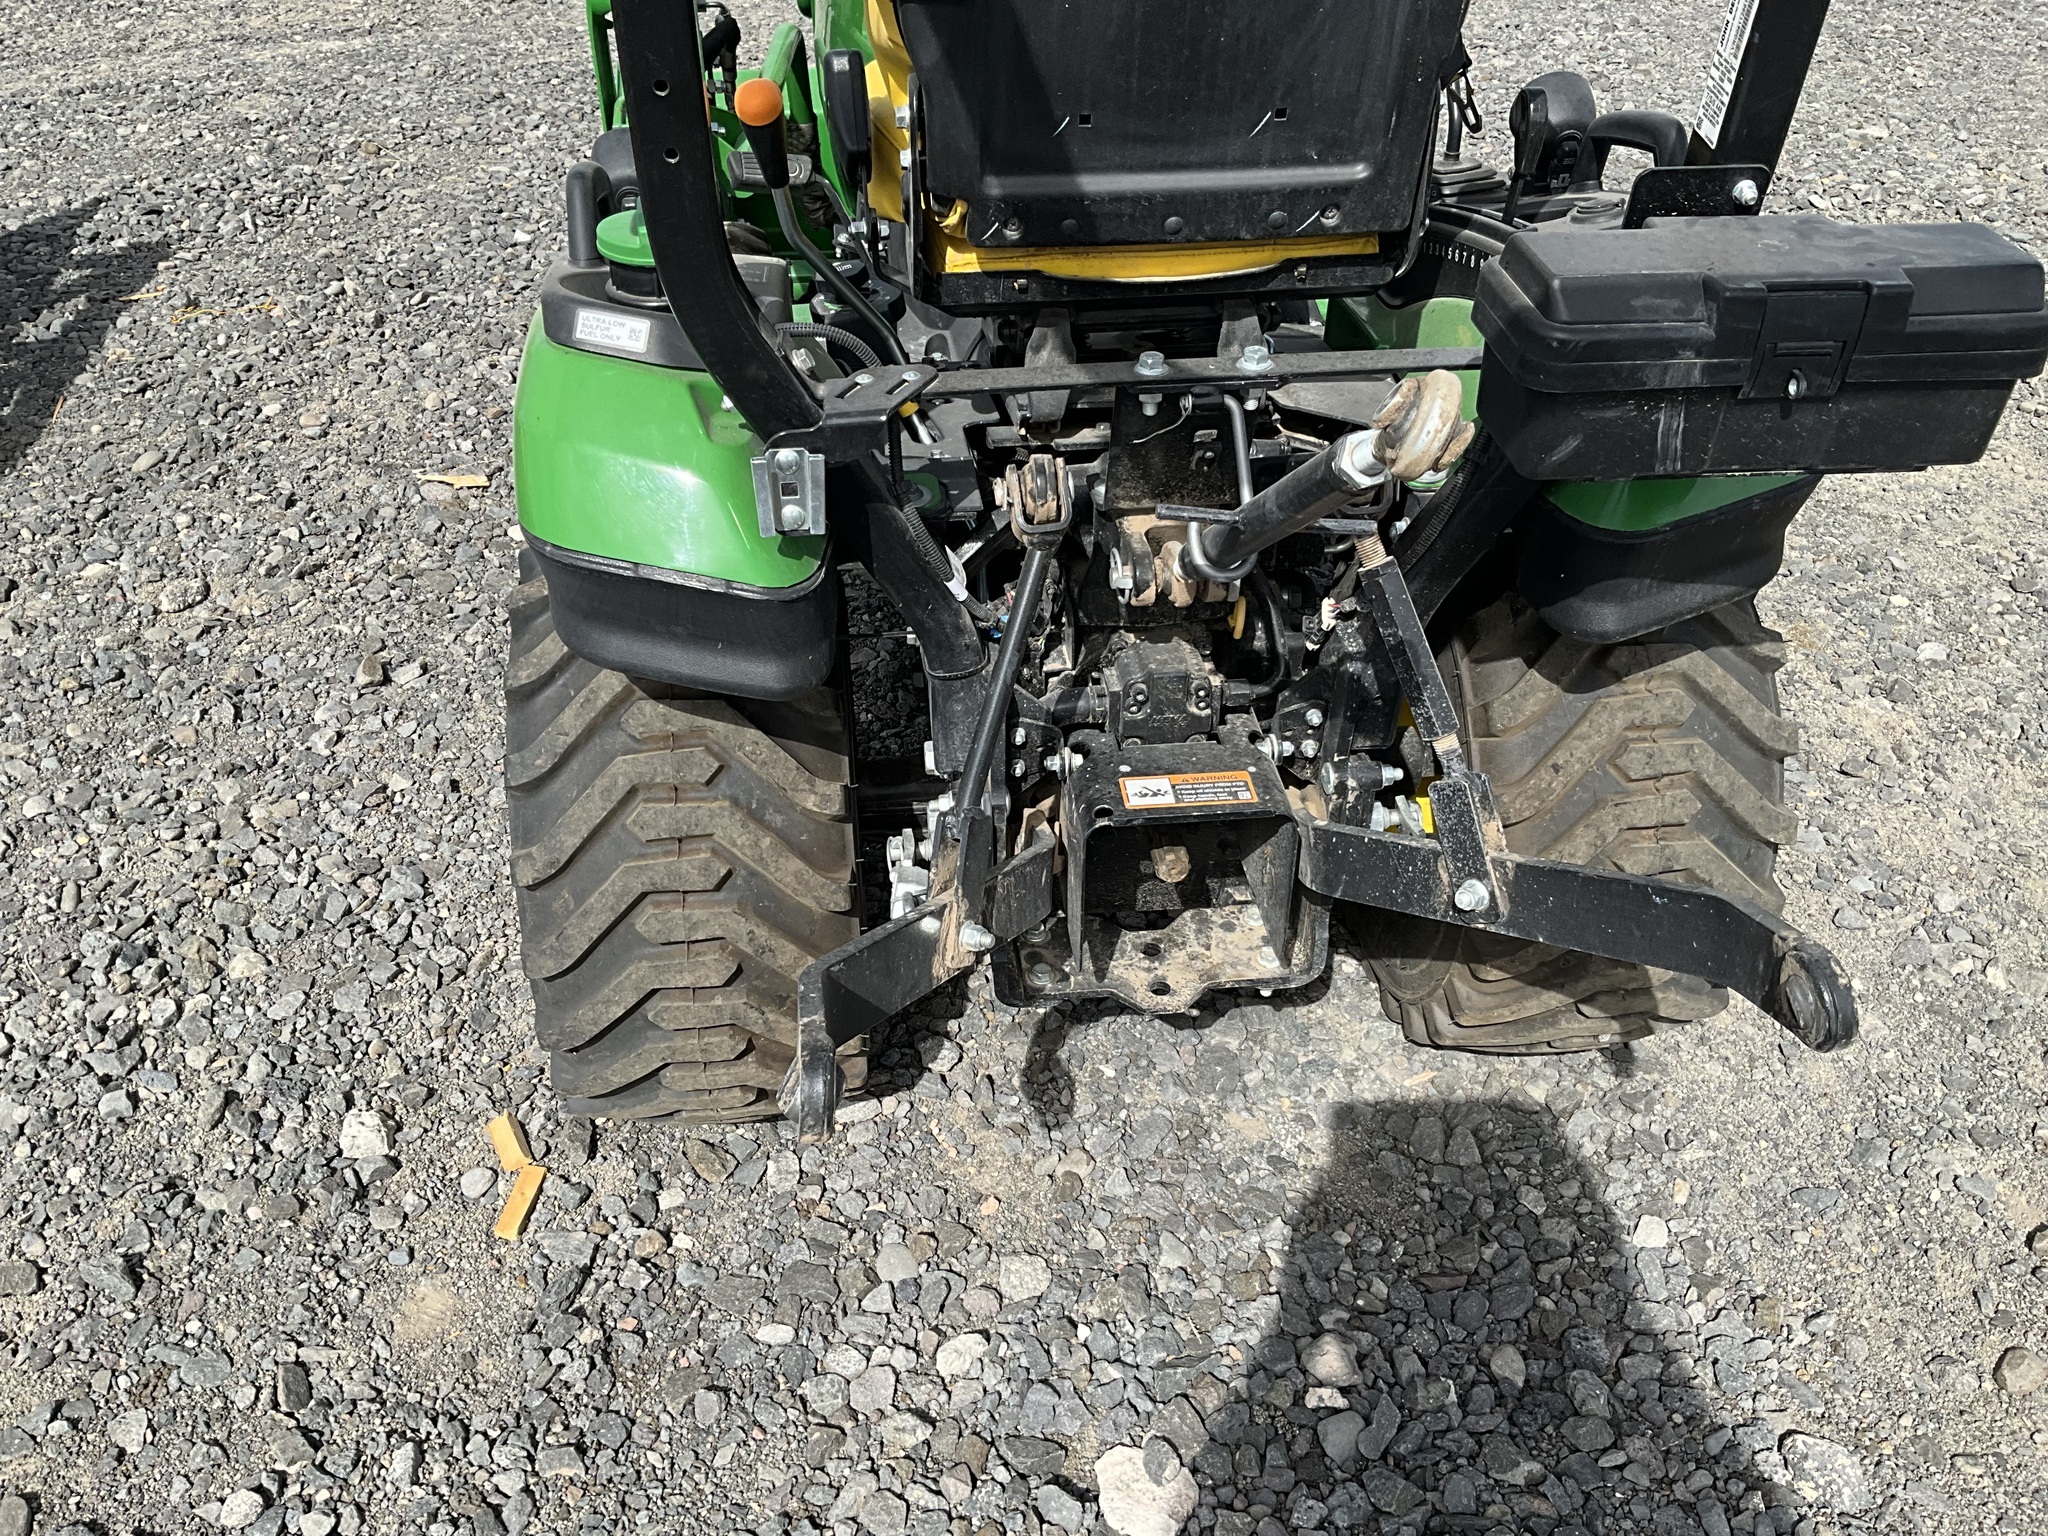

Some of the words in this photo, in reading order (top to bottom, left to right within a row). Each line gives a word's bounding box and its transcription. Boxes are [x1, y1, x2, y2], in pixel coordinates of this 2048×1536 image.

[1720, 20, 1730, 47] JOHN
[1429, 243, 1433, 254] 2
[1436, 244, 1440, 255] 3
[1448, 247, 1452, 259] 5
[1455, 249, 1459, 262] 6
[1463, 252, 1467, 264] 7
[1470, 255, 1475, 268] 8
[581, 322, 611, 333] SULFUR
[582, 315, 606, 325] ULTRA
[608, 319, 626, 328] LOW
[580, 329, 599, 339] FUEL
[600, 332, 621, 341] ONLY
